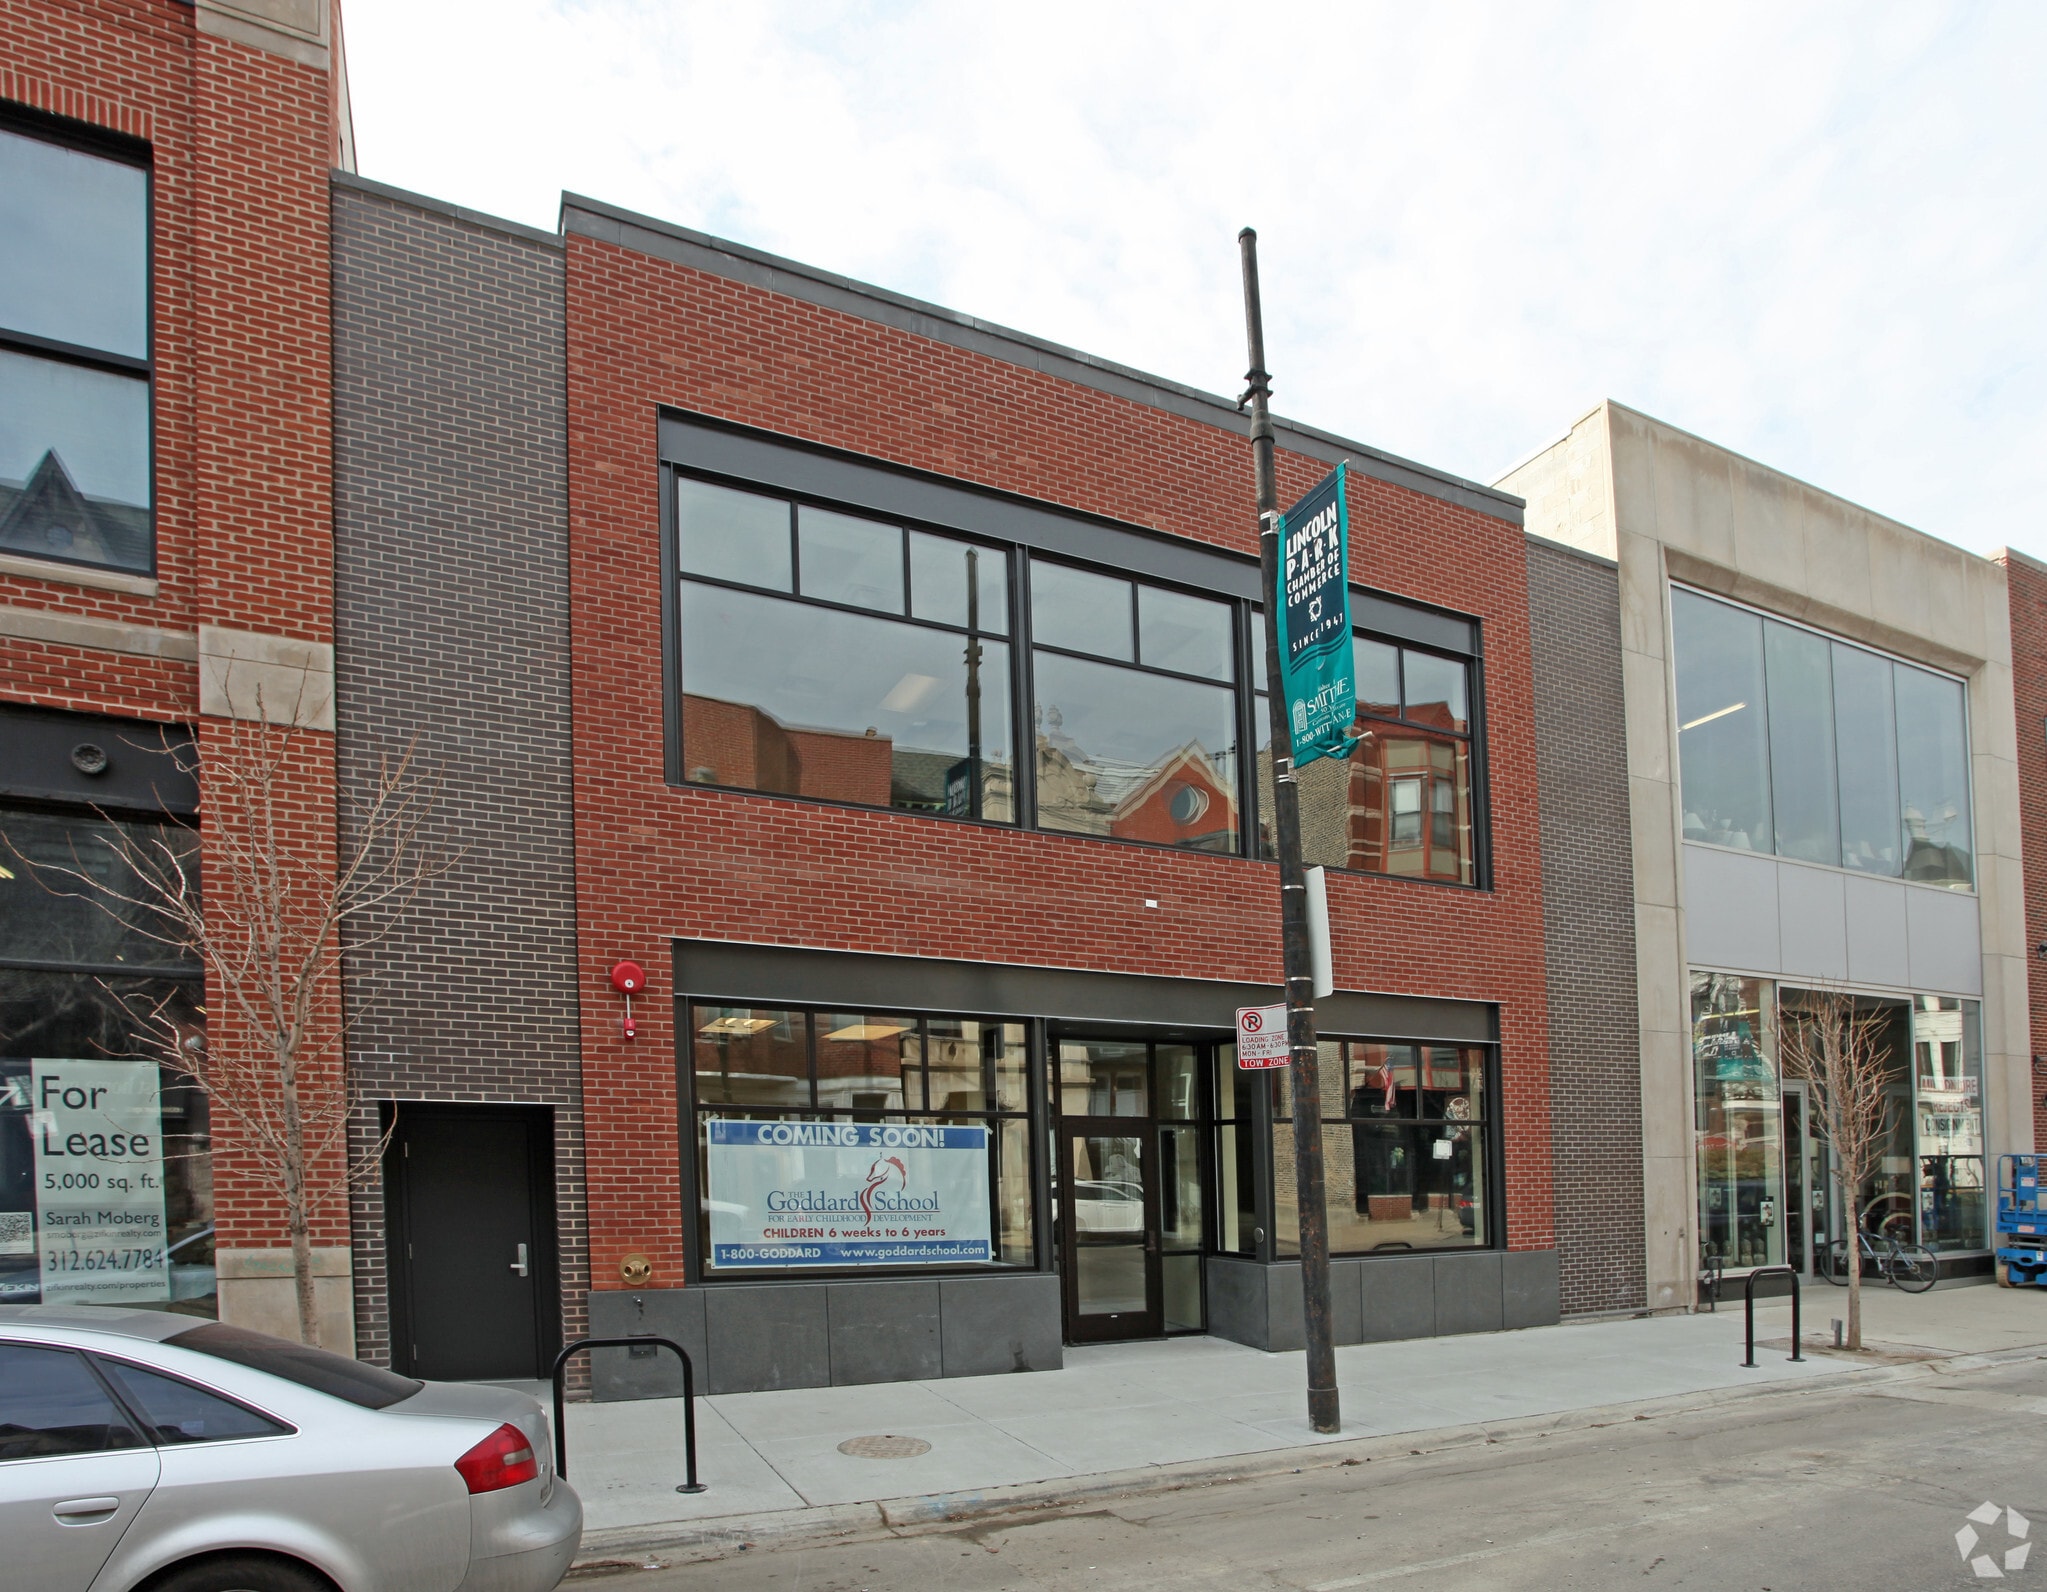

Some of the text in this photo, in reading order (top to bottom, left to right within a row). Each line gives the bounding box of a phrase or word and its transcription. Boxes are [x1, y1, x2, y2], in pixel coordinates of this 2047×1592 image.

[1286, 501, 1337, 559] LINCOLN
[1287, 548, 1340, 594] CHAMBER OF
[1288, 562, 1341, 607] COMMERCE
[1292, 612, 1343, 652] SINCE 1947
[1243, 1057, 1289, 1067] TOW ZONE
[41, 1075, 108, 1110] For
[43, 1122, 149, 1156] Lease
[757, 1124, 946, 1148] COMING SOON!
[44, 1173, 160, 1193] 5,000 sq. ft.
[766, 1190, 940, 1211] Goddard School
[787, 1191, 806, 1199] THE
[46, 1211, 160, 1228] Sarah Moberg
[768, 1213, 933, 1223] FOR EARLY CHILDHOOD DEVELOPMENT
[763, 1227, 947, 1240] CHILDREN 6 weeks to 6 years
[48, 1248, 164, 1272] 312.624.7784
[720, 1244, 986, 1260] 1-800-GODDARD www.goddardschool.com
